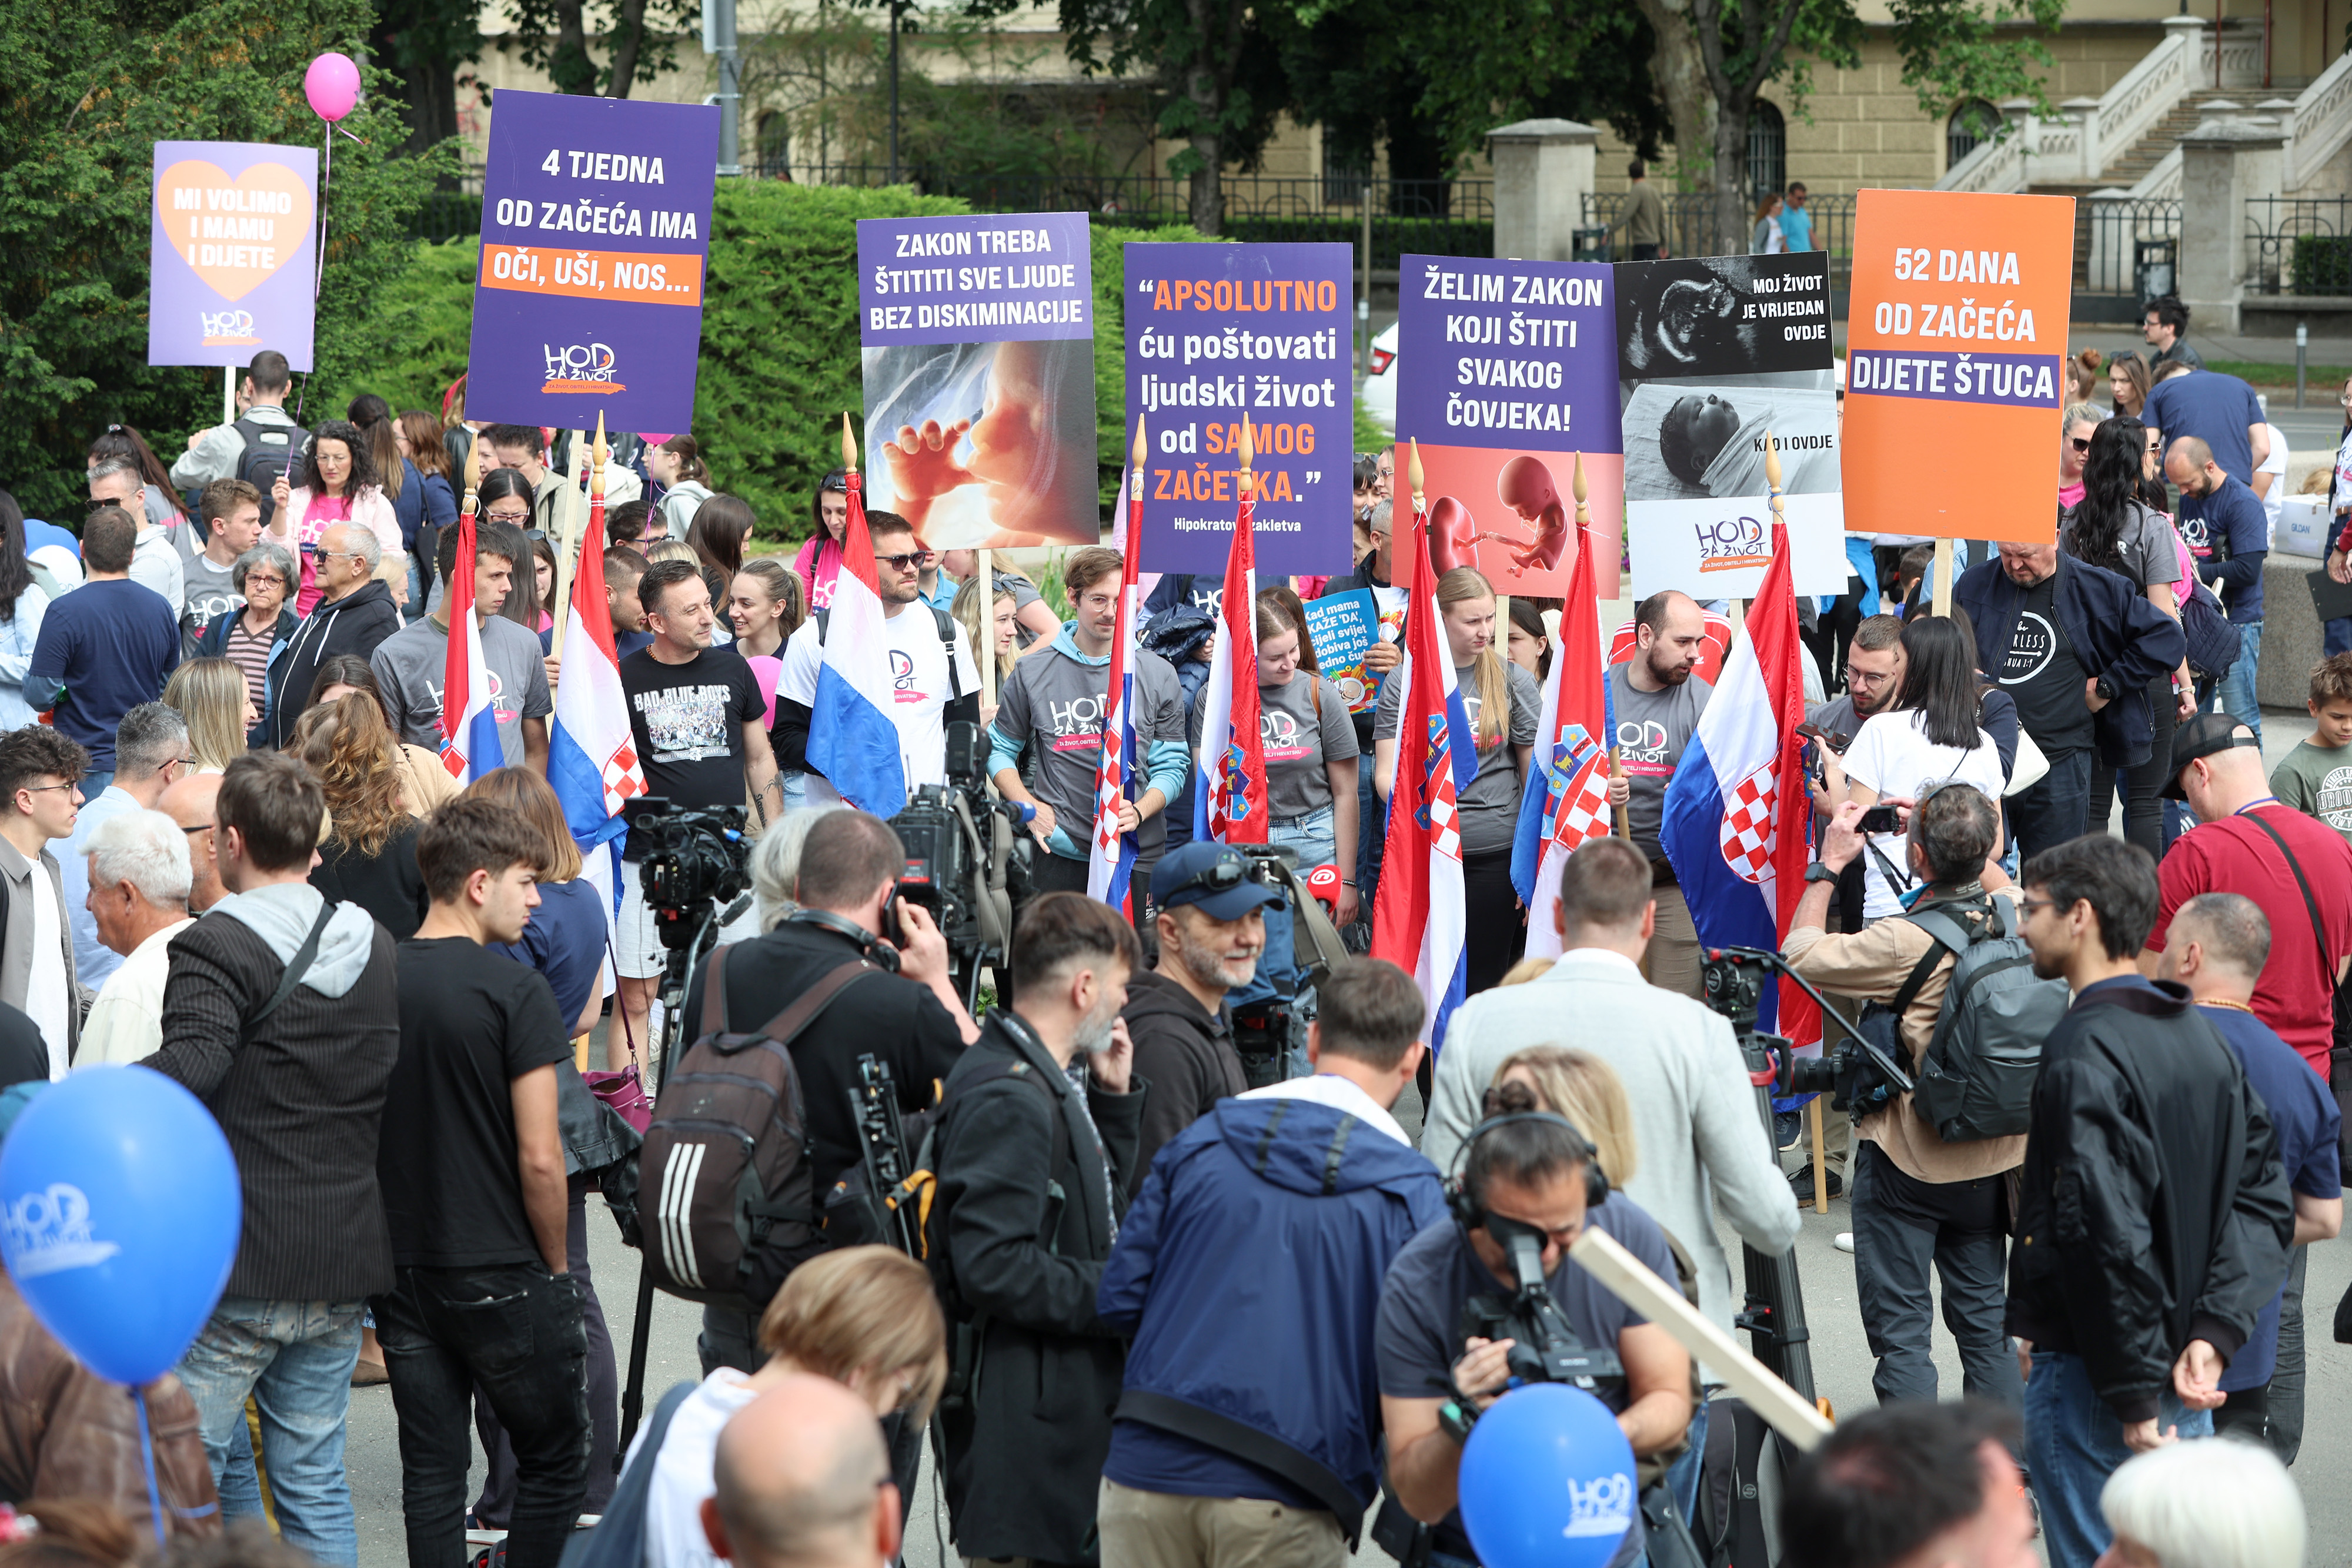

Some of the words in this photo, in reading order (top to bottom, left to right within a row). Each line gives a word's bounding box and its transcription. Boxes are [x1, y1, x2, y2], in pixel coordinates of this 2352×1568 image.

[542, 149, 560, 176] 4
[568, 151, 664, 184] TJEDNA
[174, 188, 201, 209] MI
[207, 189, 292, 214] VOLIMO
[191, 216, 198, 238] I
[203, 216, 273, 241] MAMU
[496, 198, 533, 227] OD
[539, 198, 642, 236] ZAČEĆA
[650, 210, 697, 239] IMA
[896, 232, 971, 258] ZAKON
[977, 229, 1051, 254] TREBA
[188, 244, 195, 266] I
[201, 244, 275, 269] DIJETE
[493, 246, 545, 286] OČI,
[554, 252, 605, 291] UŠI,
[613, 262, 689, 292] NOS...
[1895, 248, 1931, 281] 52
[1938, 249, 2020, 285] DANA
[875, 266, 953, 295] ŠTITITI
[959, 266, 1001, 290] SVE
[1008, 264, 1075, 289] LJUDE
[1424, 265, 1504, 303] ŽELIM
[1512, 276, 1602, 306] ZAKON
[1753, 279, 1780, 294] MOJ
[1783, 273, 1823, 292] ŽIVOT
[1139, 279, 1337, 312] “APSOLUTNO
[201, 310, 253, 329] HOD
[870, 306, 913, 330] BEZ
[918, 300, 1083, 328] DISKIMINACIJE
[1742, 304, 1758, 319] JE
[1759, 300, 1824, 318] VRIJEDAN
[1875, 302, 1912, 335] OD
[1919, 297, 2036, 342] ZAČEĆA
[204, 327, 220, 336] ZA
[1446, 315, 1501, 344] KOJI
[1509, 311, 1577, 347] ŠTITI
[1784, 325, 1826, 342] OVDJE
[544, 343, 615, 371] HOD
[1139, 326, 1175, 359] ću
[1184, 327, 1336, 365] poštovati
[545, 366, 567, 379] ZA
[570, 367, 617, 383] ŽIVOT
[1458, 357, 1562, 389] SVAKOG
[1853, 356, 1947, 393] DIJETE
[1954, 353, 2054, 399] ŠTUCA
[1141, 374, 1245, 412] ljudski
[1255, 375, 1335, 407] život
[1446, 392, 1571, 432] ČOVJEKA!
[1160, 423, 1197, 454] od
[1205, 423, 1315, 454] SAMOG
[1784, 437, 1788, 450] I
[1792, 435, 1833, 450] OVDJE
[1174, 517, 1237, 532] Hipokratov
[1252, 519, 1301, 531] zakletva
[1695, 517, 1762, 548] HOD
[2291, 523, 2311, 534] GILDAN
[1700, 544, 1719, 558] ZA
[1723, 541, 1766, 556] ŽIVOT
[1305, 607, 1324, 622] Kad
[1327, 600, 1360, 614] mama
[1308, 615, 1339, 634] KAŽE
[1312, 630, 1335, 647] cijeli
[1338, 624, 1367, 641] svijet
[1315, 641, 1351, 658] dobiva
[1353, 636, 1368, 650] još
[2013, 634, 2045, 648] RLESS
[1319, 656, 1346, 670] edno
[633, 690, 661, 712] BAD
[663, 685, 695, 706] BLUE
[698, 684, 731, 703] BOYS
[1054, 721, 1075, 736] ZA
[1620, 747, 1670, 765] ŽIVOT
[2326, 770, 2344, 788] STREET
[2330, 814, 2345, 827] NEW
[1566, 1473, 1632, 1510] HOD
